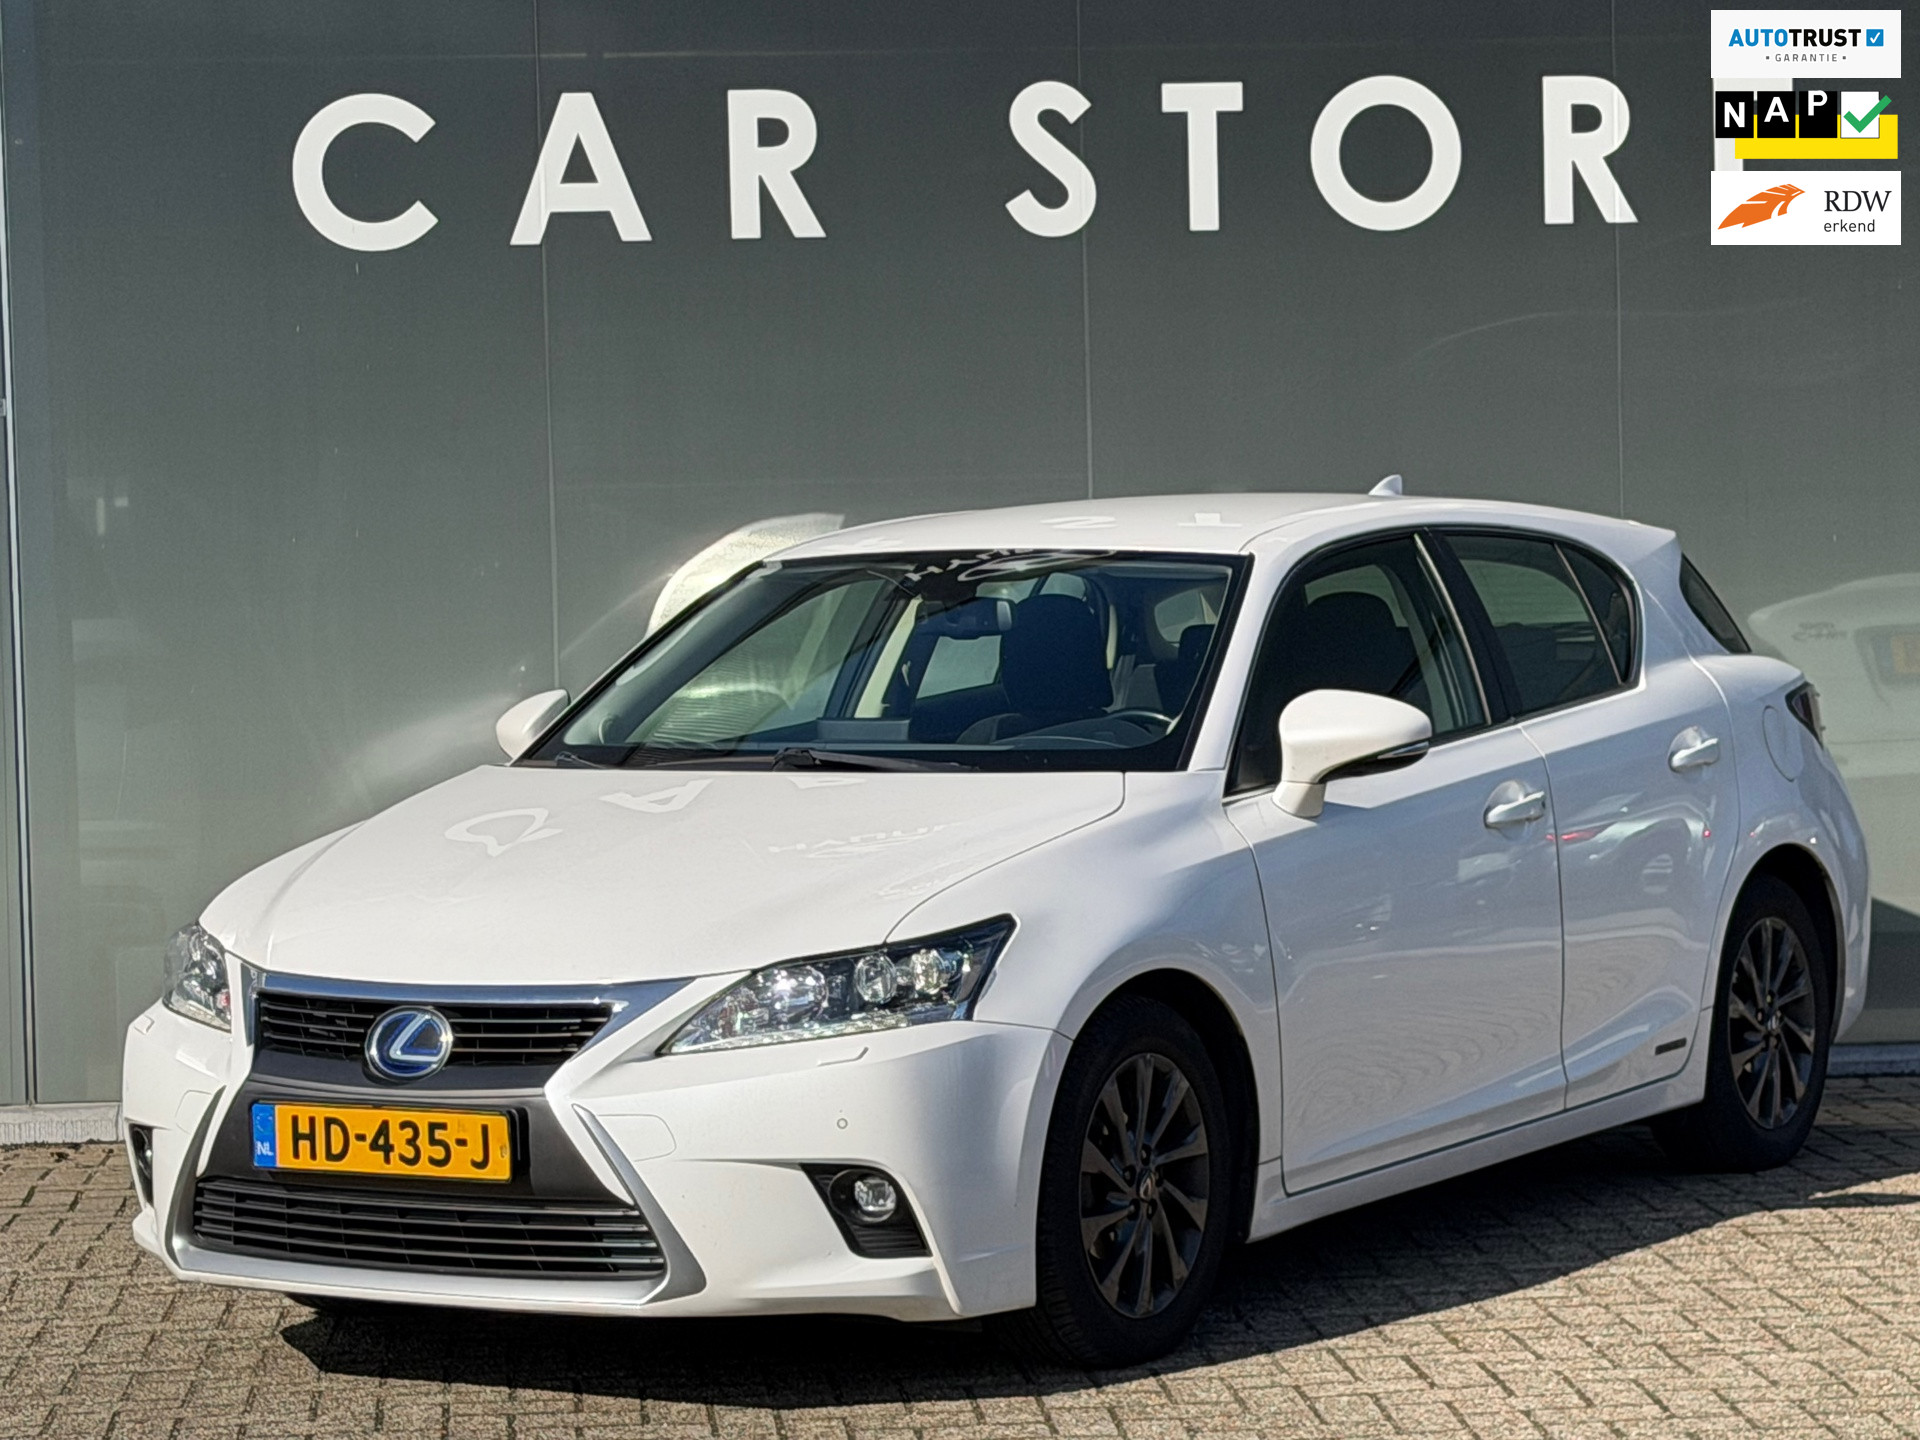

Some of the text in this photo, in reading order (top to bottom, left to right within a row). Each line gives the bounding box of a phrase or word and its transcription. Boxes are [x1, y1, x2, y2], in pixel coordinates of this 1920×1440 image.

[292, 89, 826, 252] CAR
[255, 1142, 274, 1156] NL
[290, 1114, 491, 1170] HD-435-J
